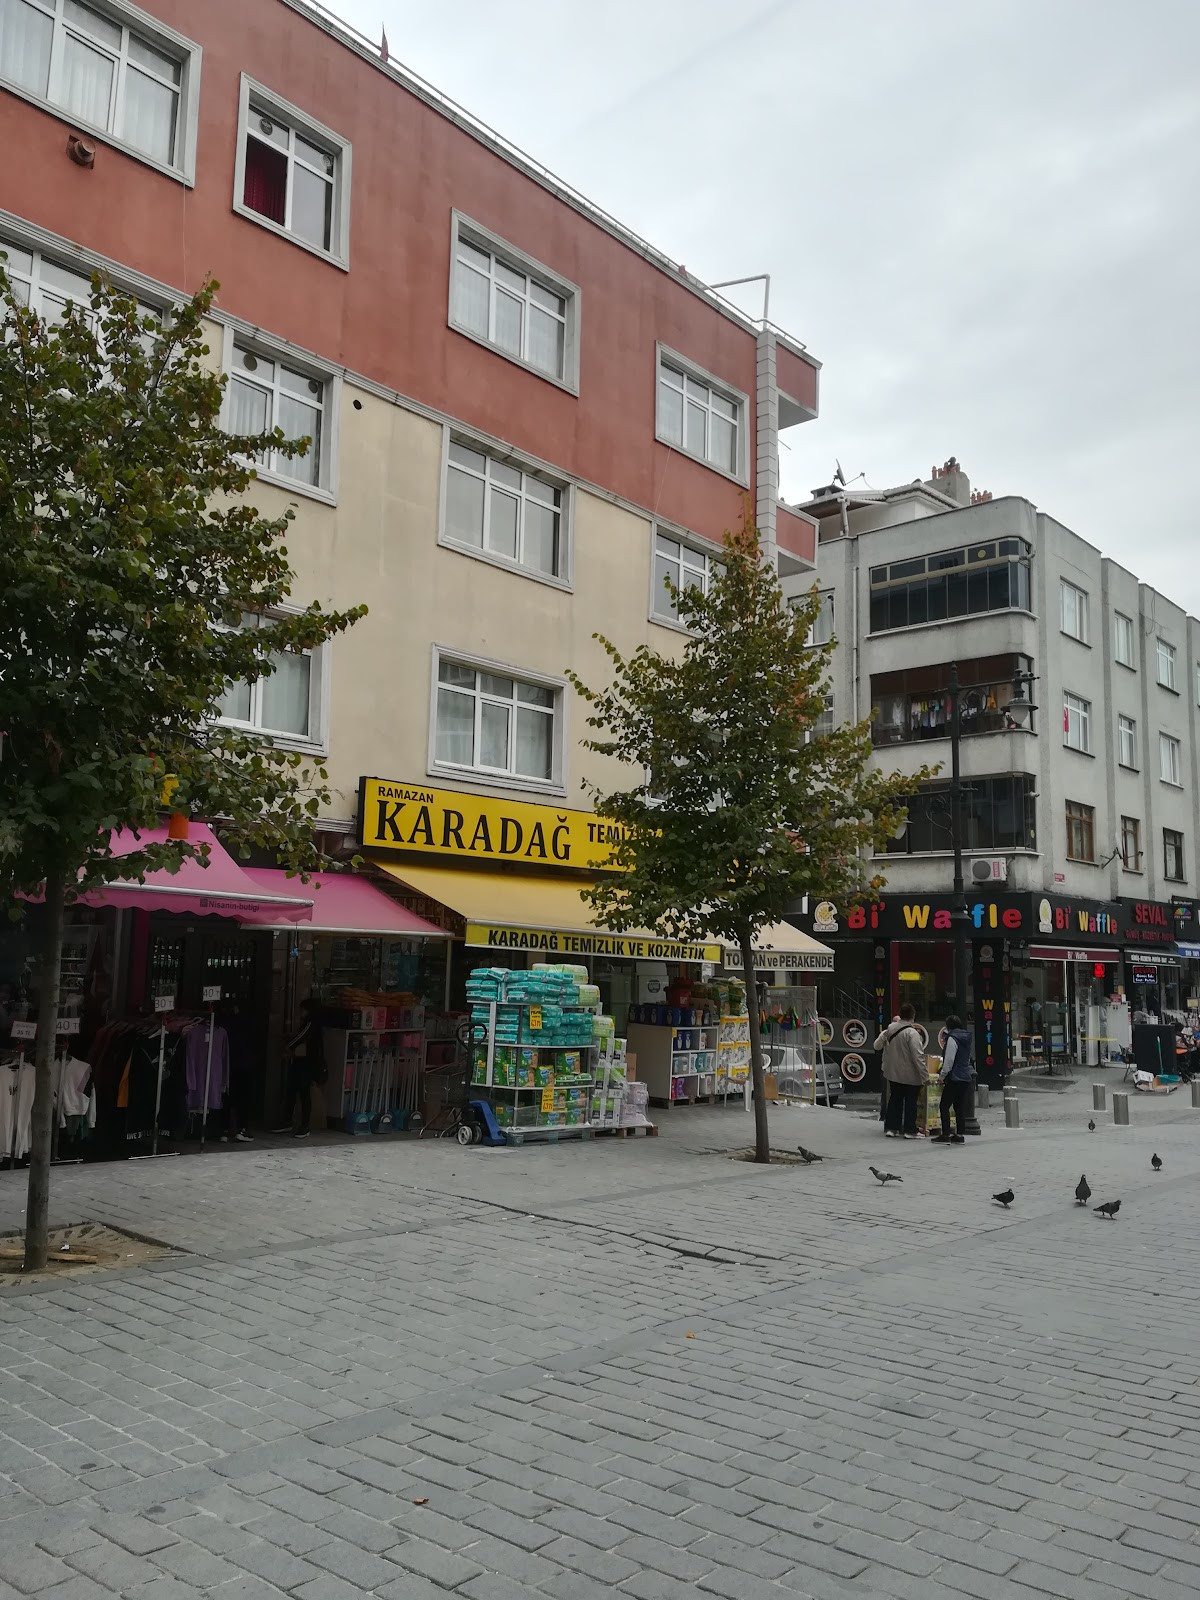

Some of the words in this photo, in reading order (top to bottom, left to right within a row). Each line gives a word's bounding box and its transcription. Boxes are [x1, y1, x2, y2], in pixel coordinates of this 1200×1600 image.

[378, 786, 434, 804] RAMAZAN
[374, 799, 571, 861] KARADAĞ
[903, 903, 1022, 930] Wafle
[1078, 910, 1118, 935] Waffle
[1135, 902, 1169, 927] SEVAL
[488, 929, 559, 950] KARADAĞ
[563, 935, 625, 956] TEMİZLİK
[628, 941, 645, 957] VE
[648, 943, 706, 960] KOZMETİK
[725, 952, 766, 968] TOAN
[767, 956, 779, 968] ve
[780, 954, 833, 969] PERAKENDE
